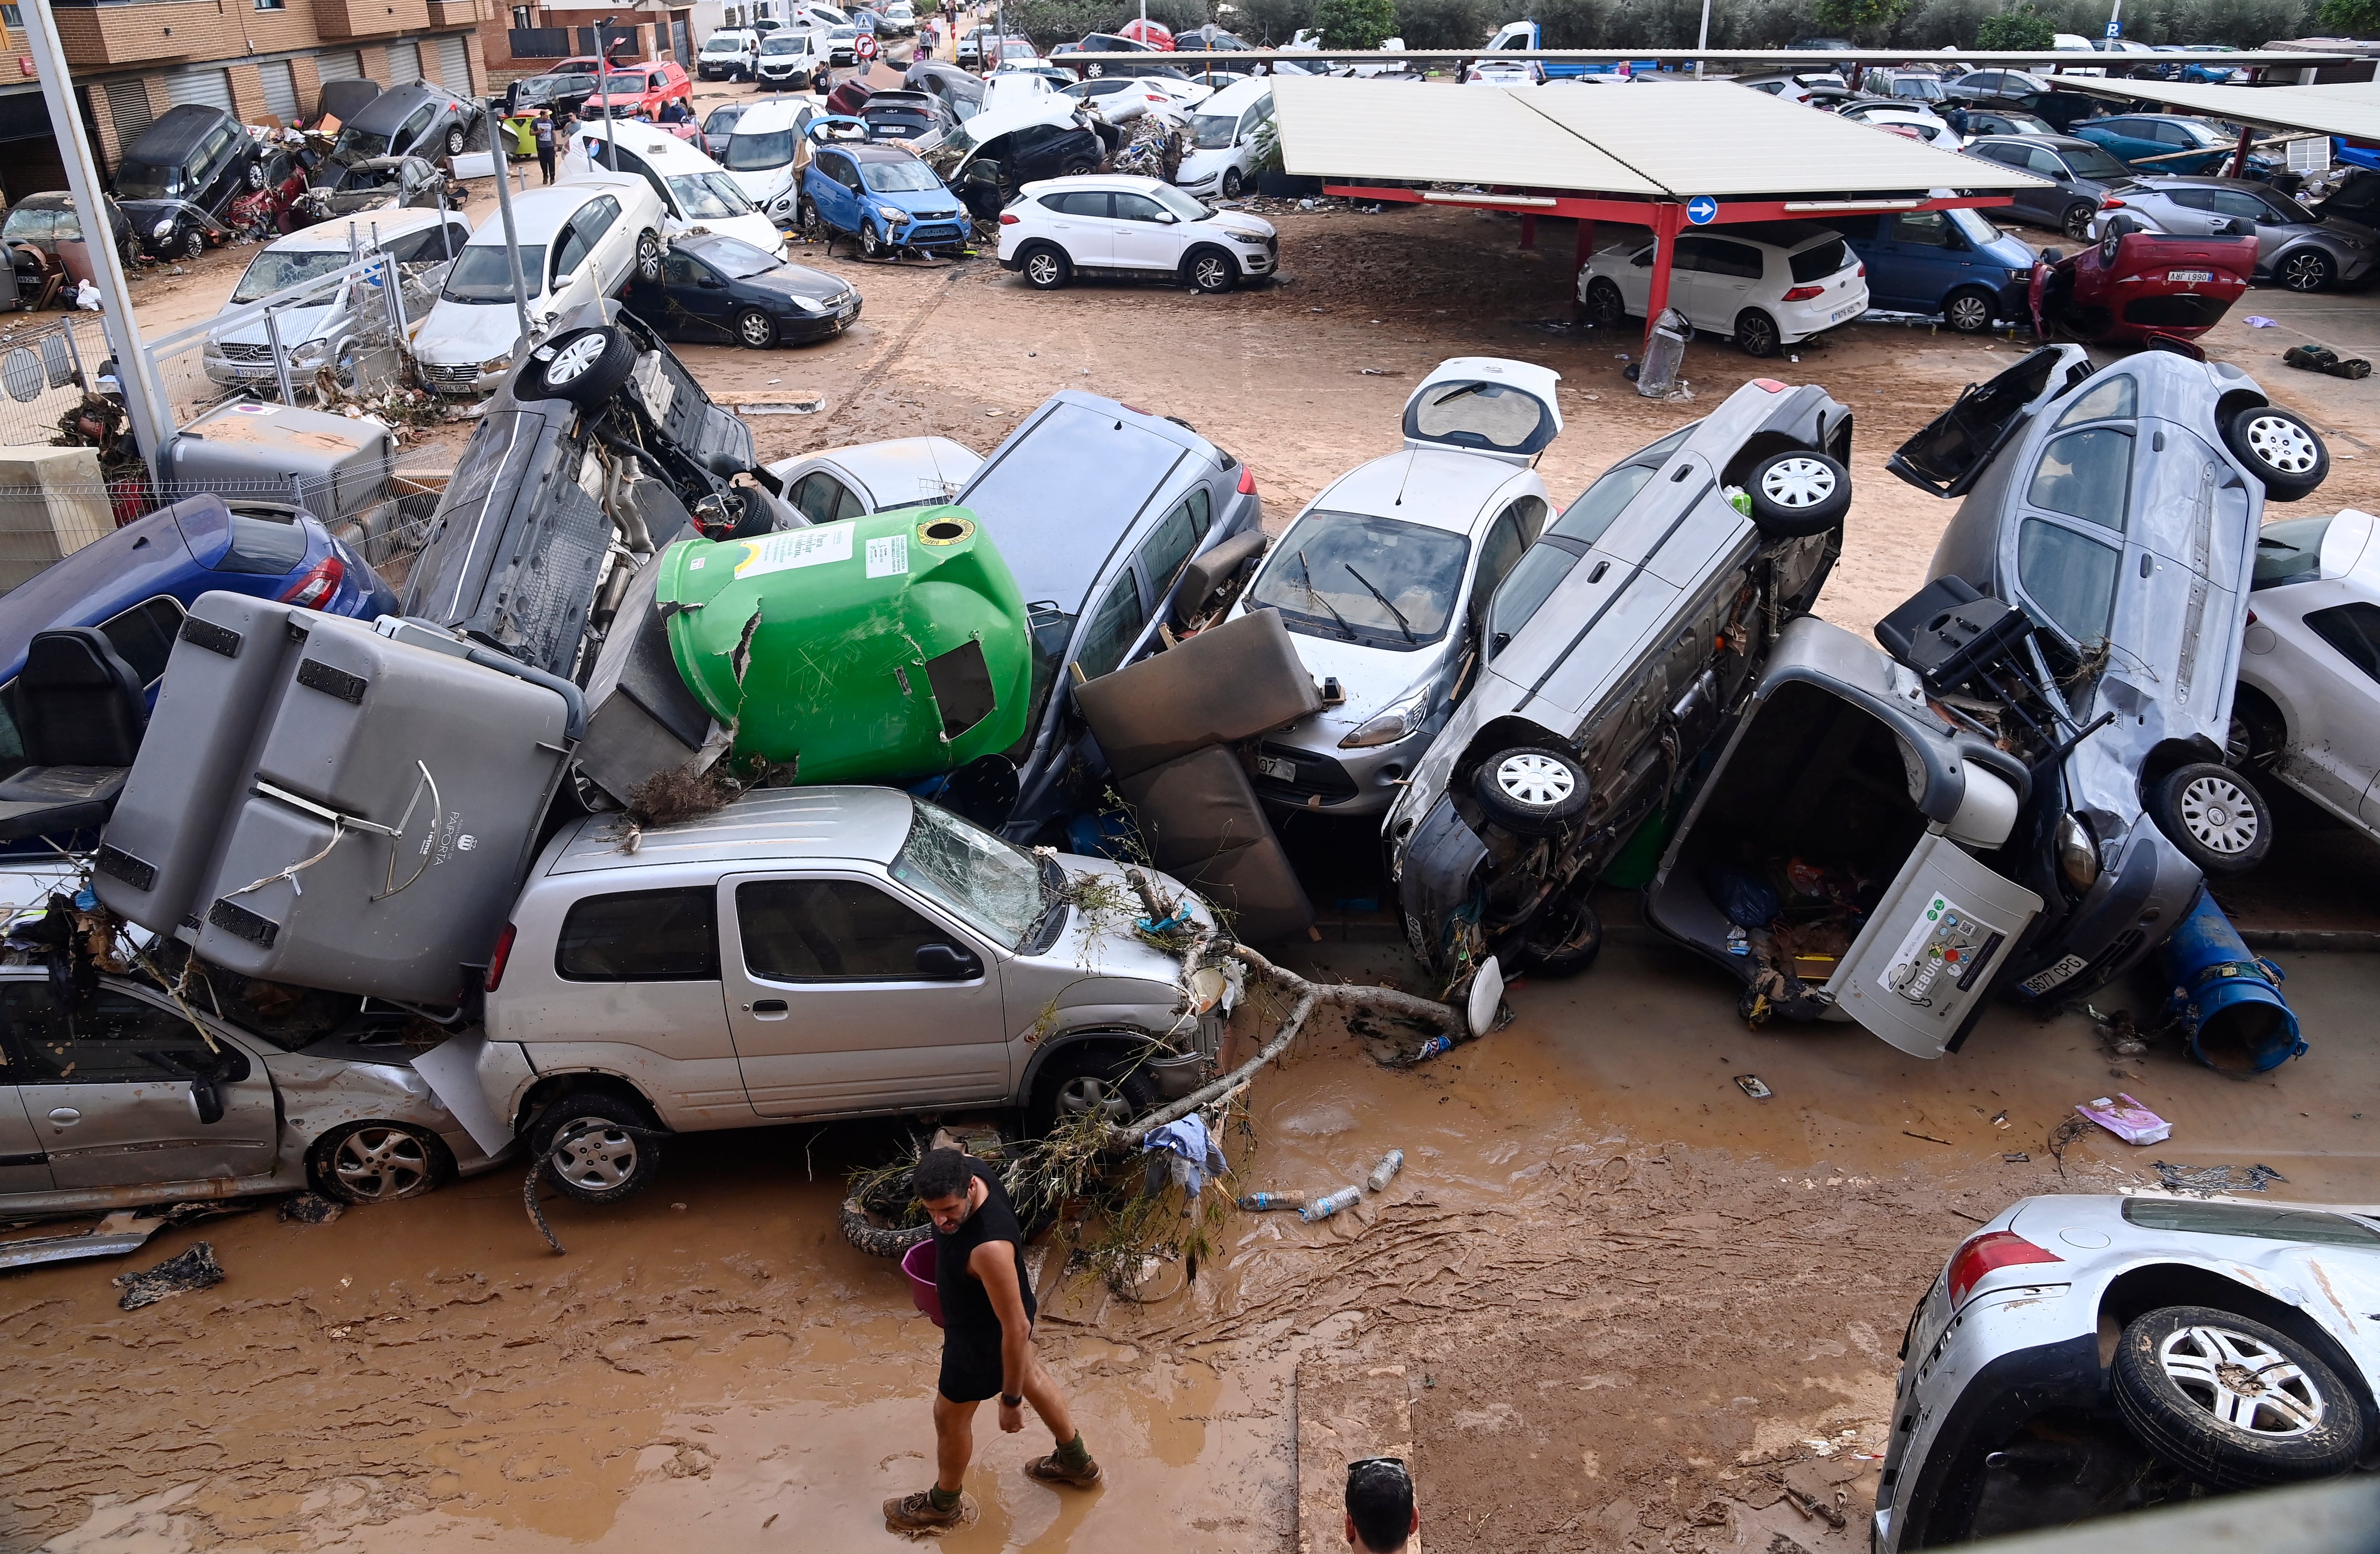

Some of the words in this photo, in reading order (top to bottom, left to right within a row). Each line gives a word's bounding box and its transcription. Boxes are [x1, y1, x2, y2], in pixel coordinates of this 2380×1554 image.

[793, 538, 806, 558] vidrio,
[805, 534, 816, 553] reciclar
[816, 534, 828, 547] Para
[433, 812, 460, 865] PAIPORTA
[450, 819, 464, 851] AJUNTAMENT
[1909, 957, 1943, 998] REBUIG
[2026, 972, 2055, 991] 9677
[2053, 958, 2081, 977] CPG
